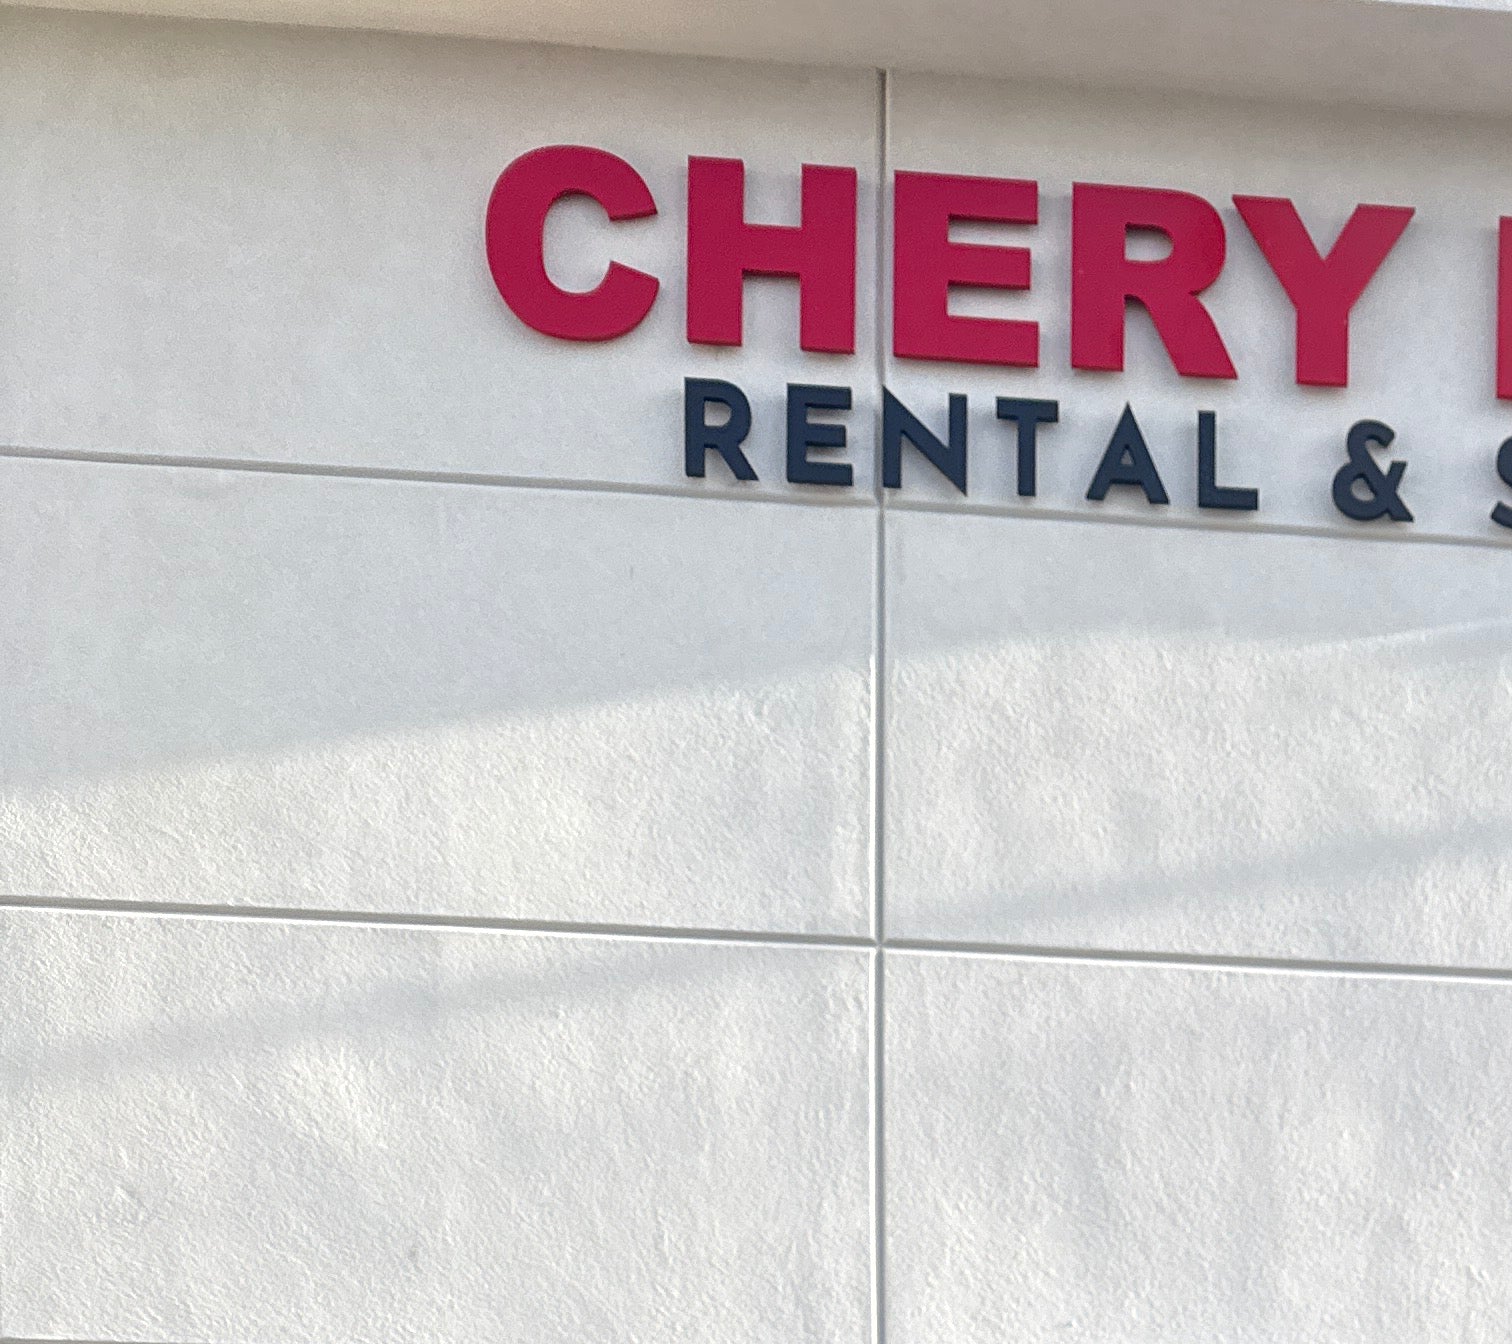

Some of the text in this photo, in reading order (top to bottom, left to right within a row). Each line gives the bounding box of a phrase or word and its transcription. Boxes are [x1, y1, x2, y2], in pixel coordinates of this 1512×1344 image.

[486, 145, 1415, 387] CHERY
[683, 377, 1259, 511] RENTAL
[1331, 419, 1414, 523] &
